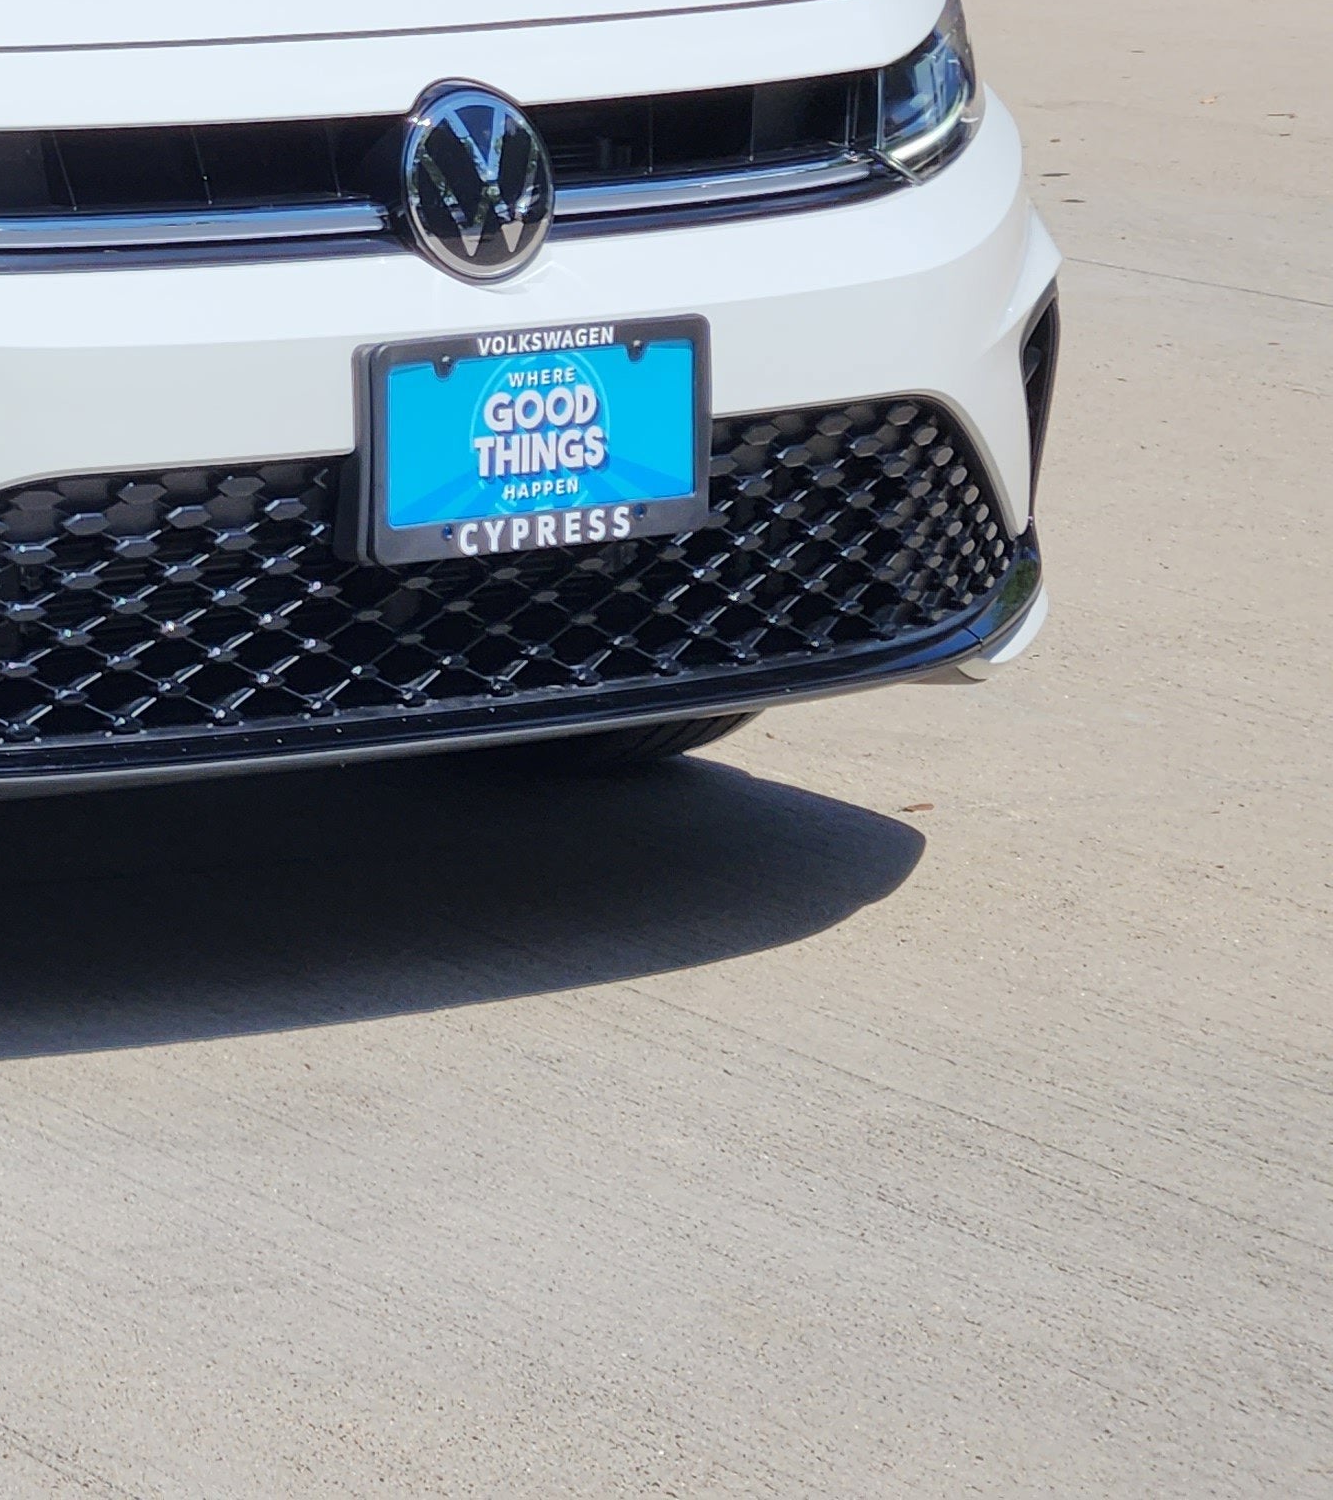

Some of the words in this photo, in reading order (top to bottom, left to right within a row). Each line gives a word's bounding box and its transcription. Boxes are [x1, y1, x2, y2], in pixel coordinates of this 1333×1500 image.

[476, 326, 615, 357] VOLKSWAGEN
[507, 366, 576, 388] WHERE
[484, 384, 599, 432] GOOD
[474, 428, 606, 478] THINGS
[501, 477, 580, 501] HAPPEN
[458, 505, 632, 557] CYPRESS
